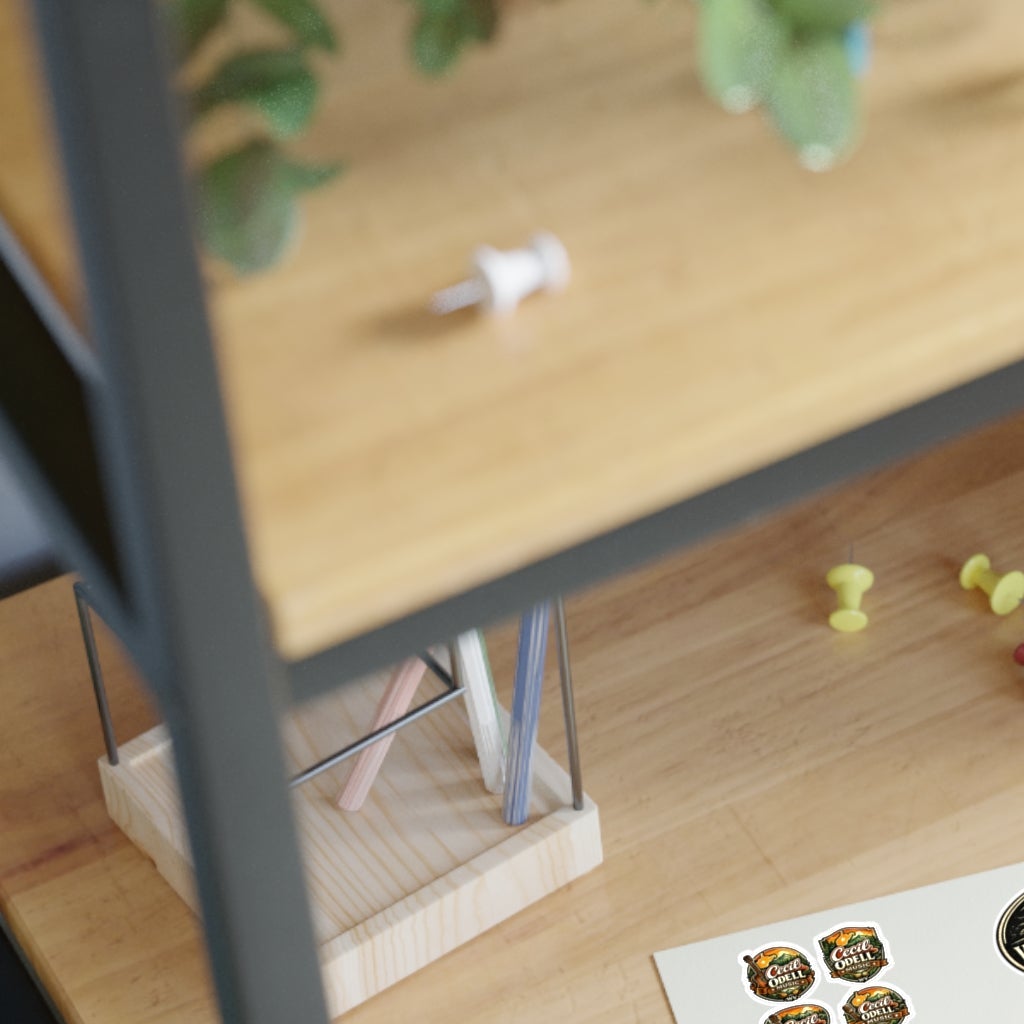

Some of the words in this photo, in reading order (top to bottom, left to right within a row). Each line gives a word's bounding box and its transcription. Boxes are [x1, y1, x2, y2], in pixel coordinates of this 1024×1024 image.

[831, 938, 871, 962] Cecil
[765, 957, 802, 979] Cecil
[834, 950, 876, 971] ODELL
[845, 961, 871, 972] MUSIC
[768, 969, 807, 988] ODELL
[776, 980, 800, 990] MUSIC
[858, 995, 892, 1014] Cecil
[861, 1005, 895, 1021] ODELL
[867, 1014, 893, 1024] MUSIC
